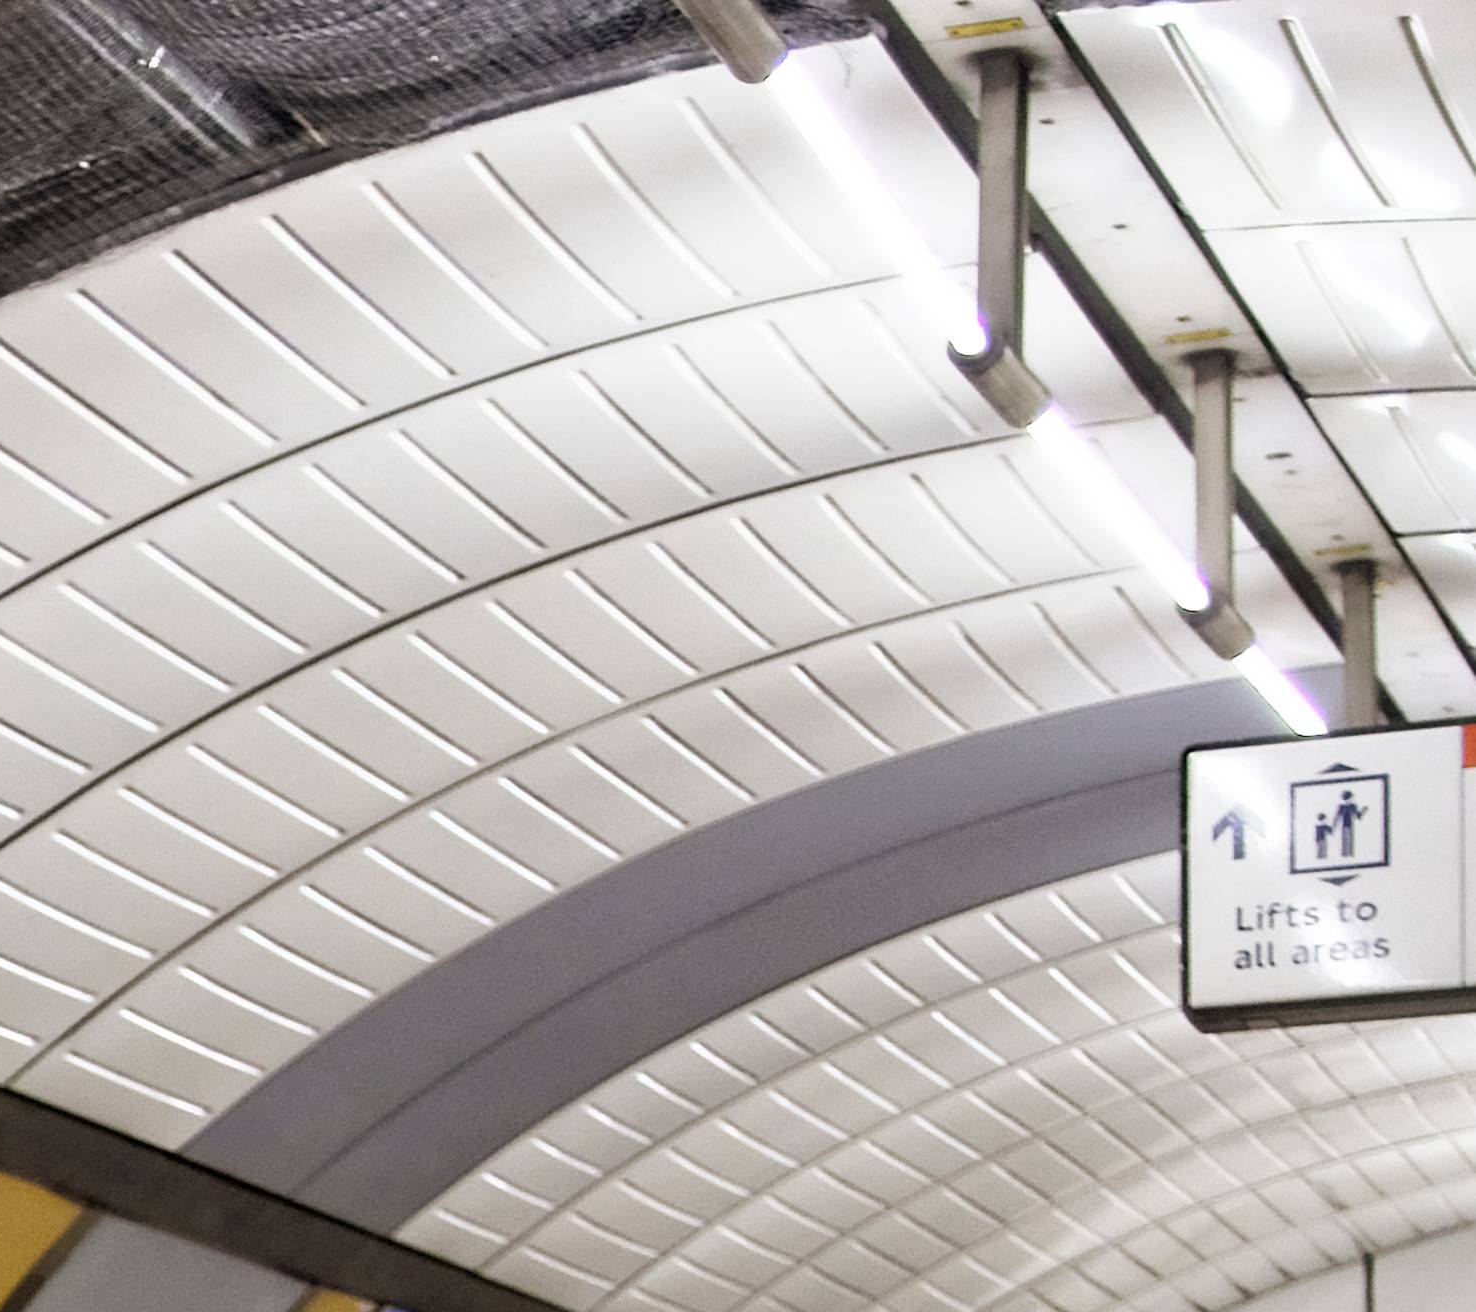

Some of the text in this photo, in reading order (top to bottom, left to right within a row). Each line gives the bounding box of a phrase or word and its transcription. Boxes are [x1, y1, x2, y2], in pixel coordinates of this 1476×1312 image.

[1235, 898, 1377, 932] Lifts to
[1234, 935, 1390, 971] all areas
